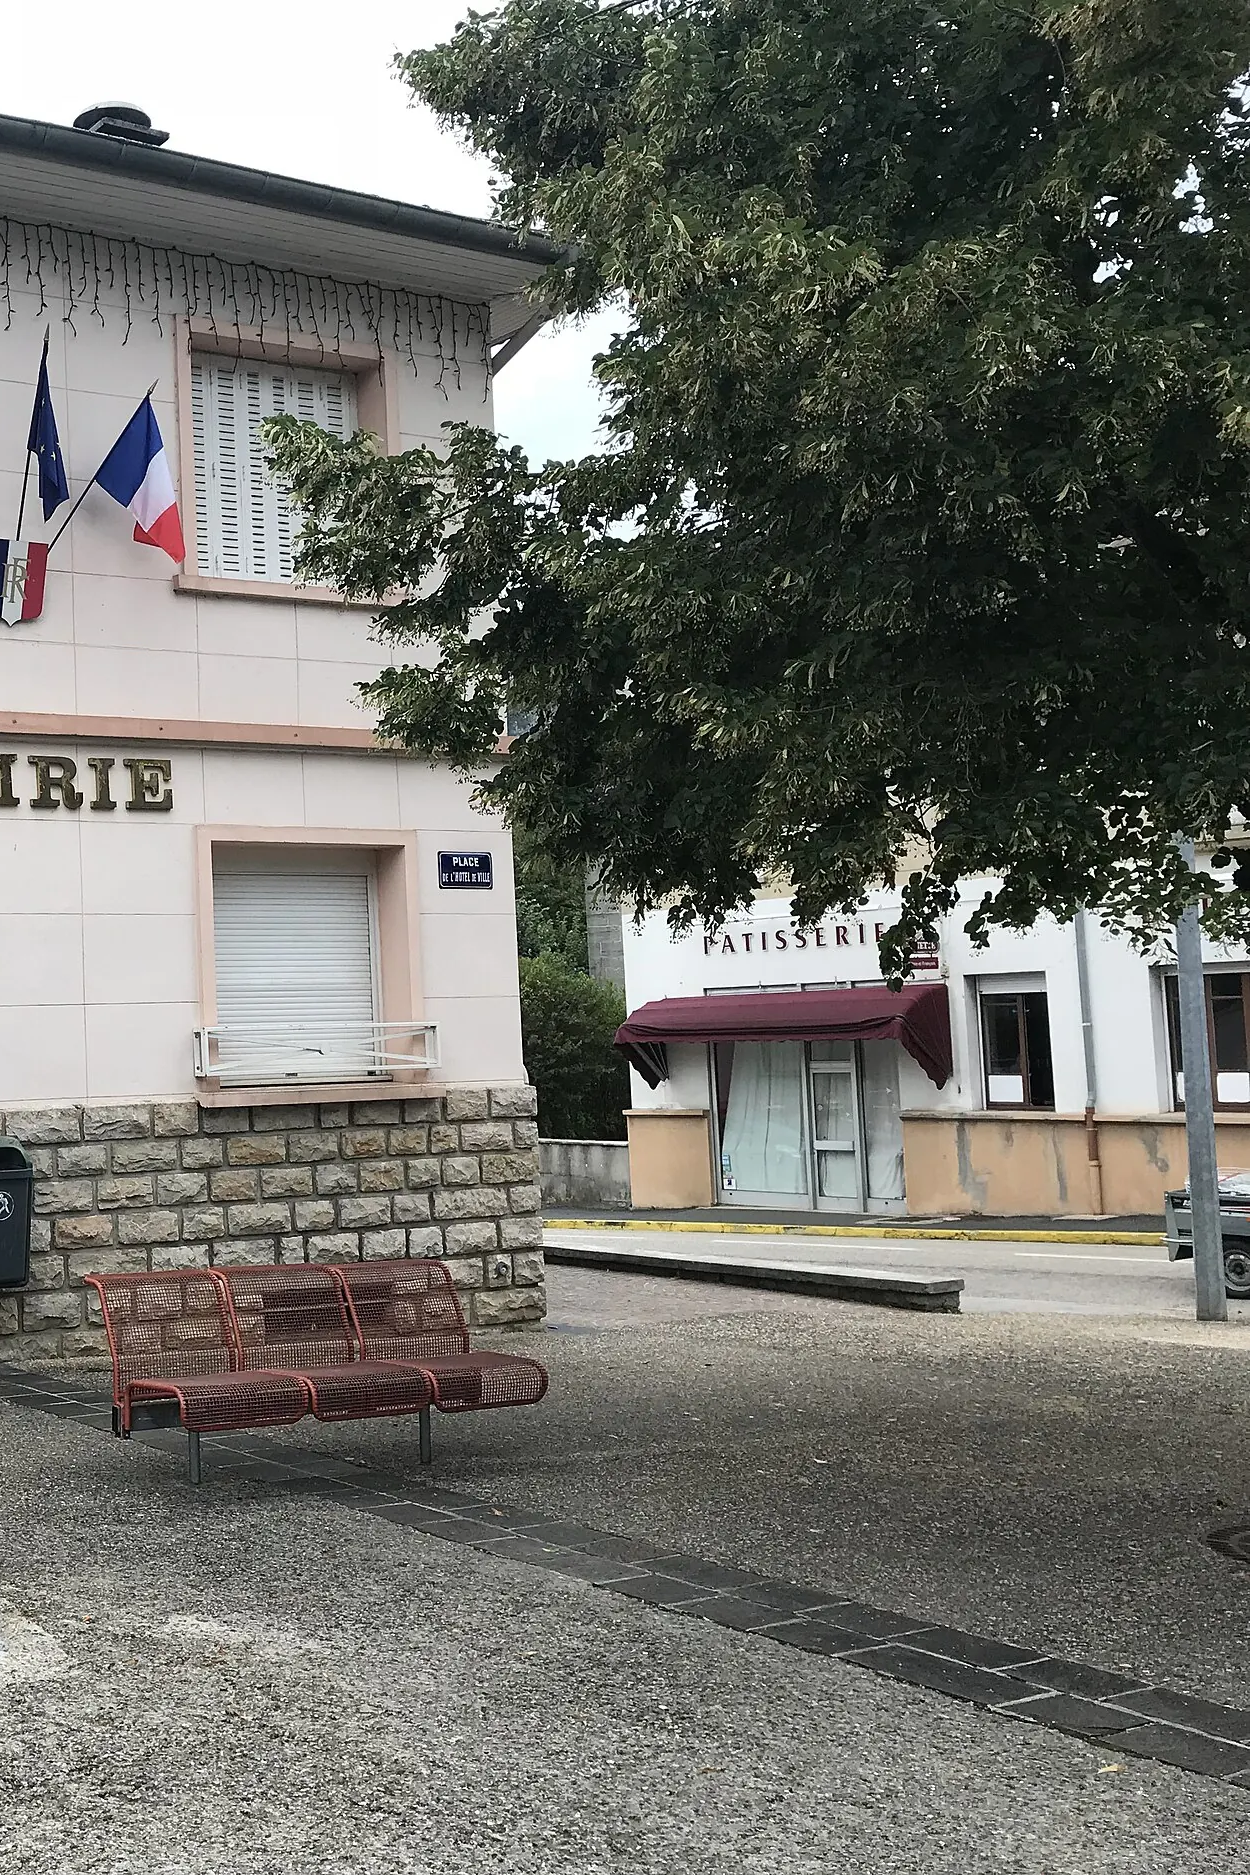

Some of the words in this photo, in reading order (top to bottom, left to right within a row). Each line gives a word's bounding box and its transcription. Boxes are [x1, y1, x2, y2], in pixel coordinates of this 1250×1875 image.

[452, 856, 480, 867] PLACE
[442, 872, 449, 882] DE
[477, 872, 491, 882] VILLE
